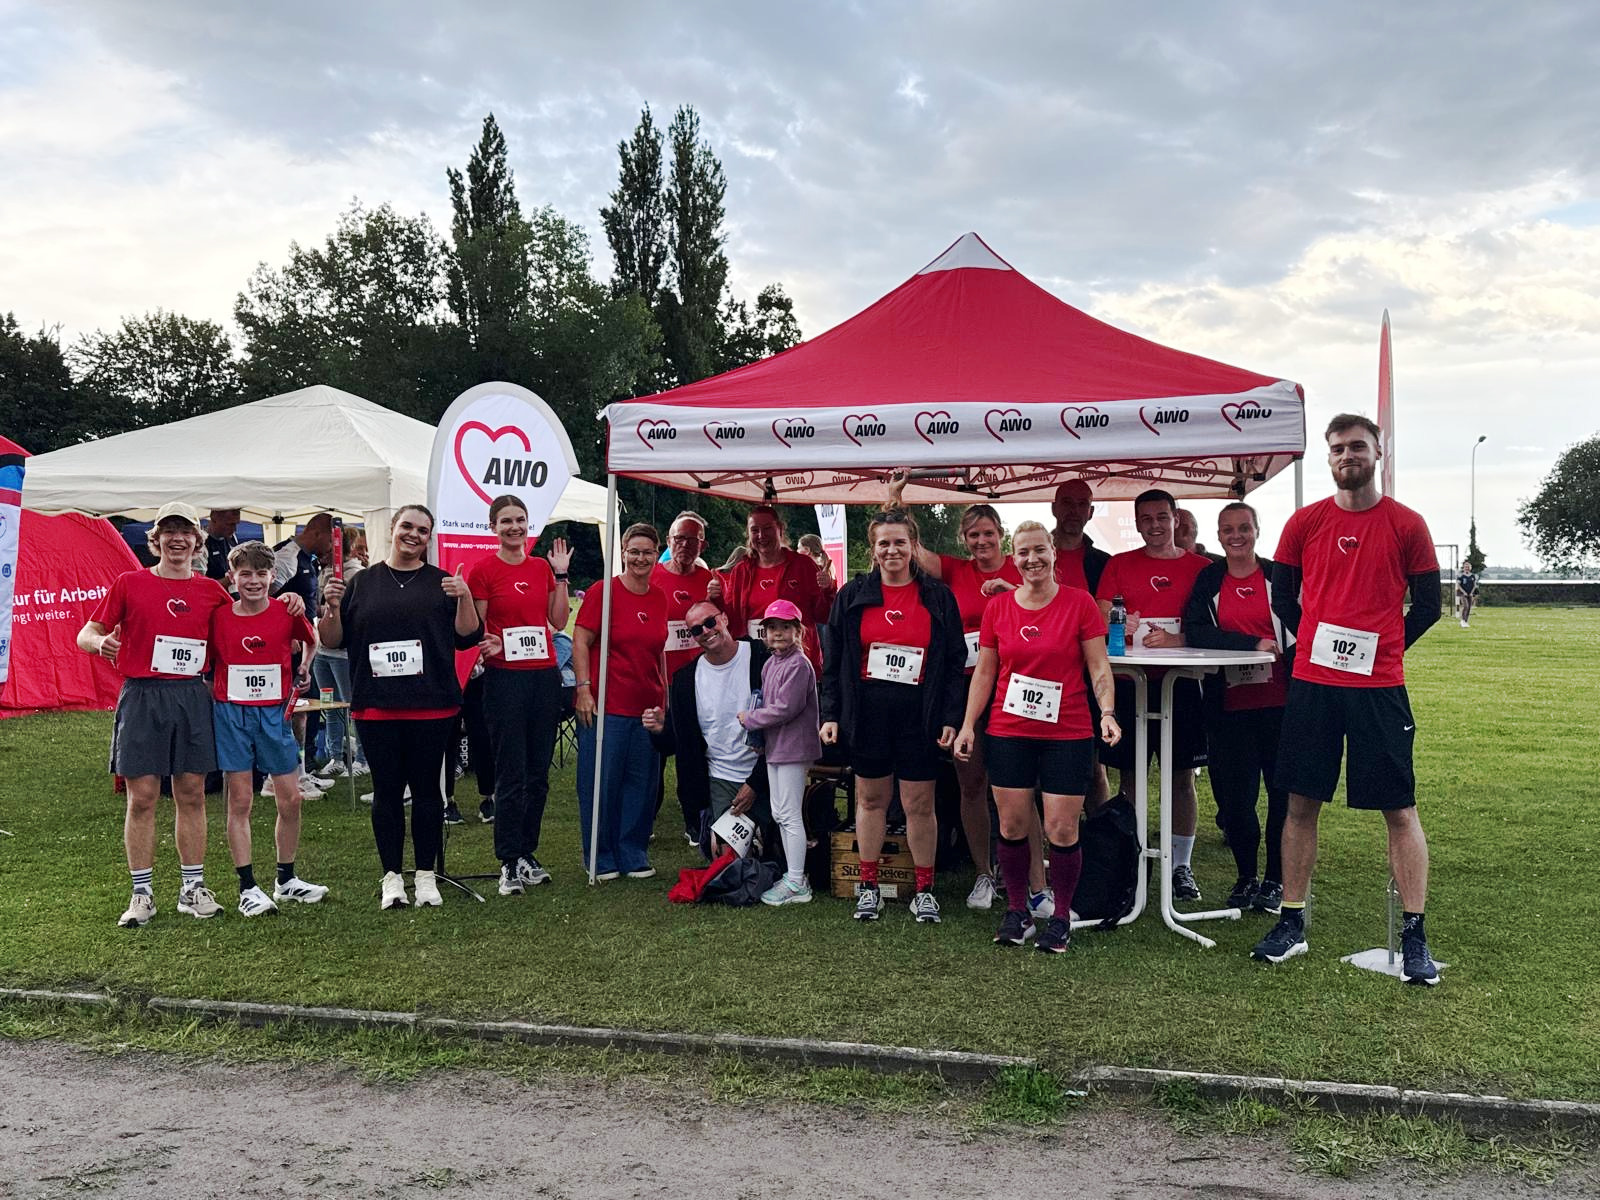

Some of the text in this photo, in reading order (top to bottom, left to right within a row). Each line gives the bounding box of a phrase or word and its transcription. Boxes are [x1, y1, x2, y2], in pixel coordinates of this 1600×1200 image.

[1075, 414, 1109, 429] AWO
[1153, 409, 1189, 425] AWO
[784, 425, 815, 438] AWO
[855, 423, 886, 437] AWO
[927, 421, 959, 434] AWO
[999, 418, 1032, 432] AWO
[647, 427, 677, 440] AWO
[715, 427, 745, 439] AWO
[482, 457, 548, 488] AWO
[442, 520, 459, 528] Stark
[460, 521, 474, 529] und
[475, 523, 491, 531] eng
[442, 542, 501, 551] www.awo-vorpom
[34, 589, 56, 605] für
[60, 585, 107, 603] Arbeit
[12, 609, 75, 625] ngt weiter.
[519, 636, 537, 647] 100
[1333, 640, 1357, 656] 102
[171, 648, 192, 662] 105
[386, 651, 407, 663] 100
[885, 654, 906, 668] 100
[245, 676, 266, 687] 105
[1022, 689, 1044, 705] 102
[460, 736, 468, 768] adida
[732, 822, 749, 840] 103
[842, 865, 908, 880] Stöeker
